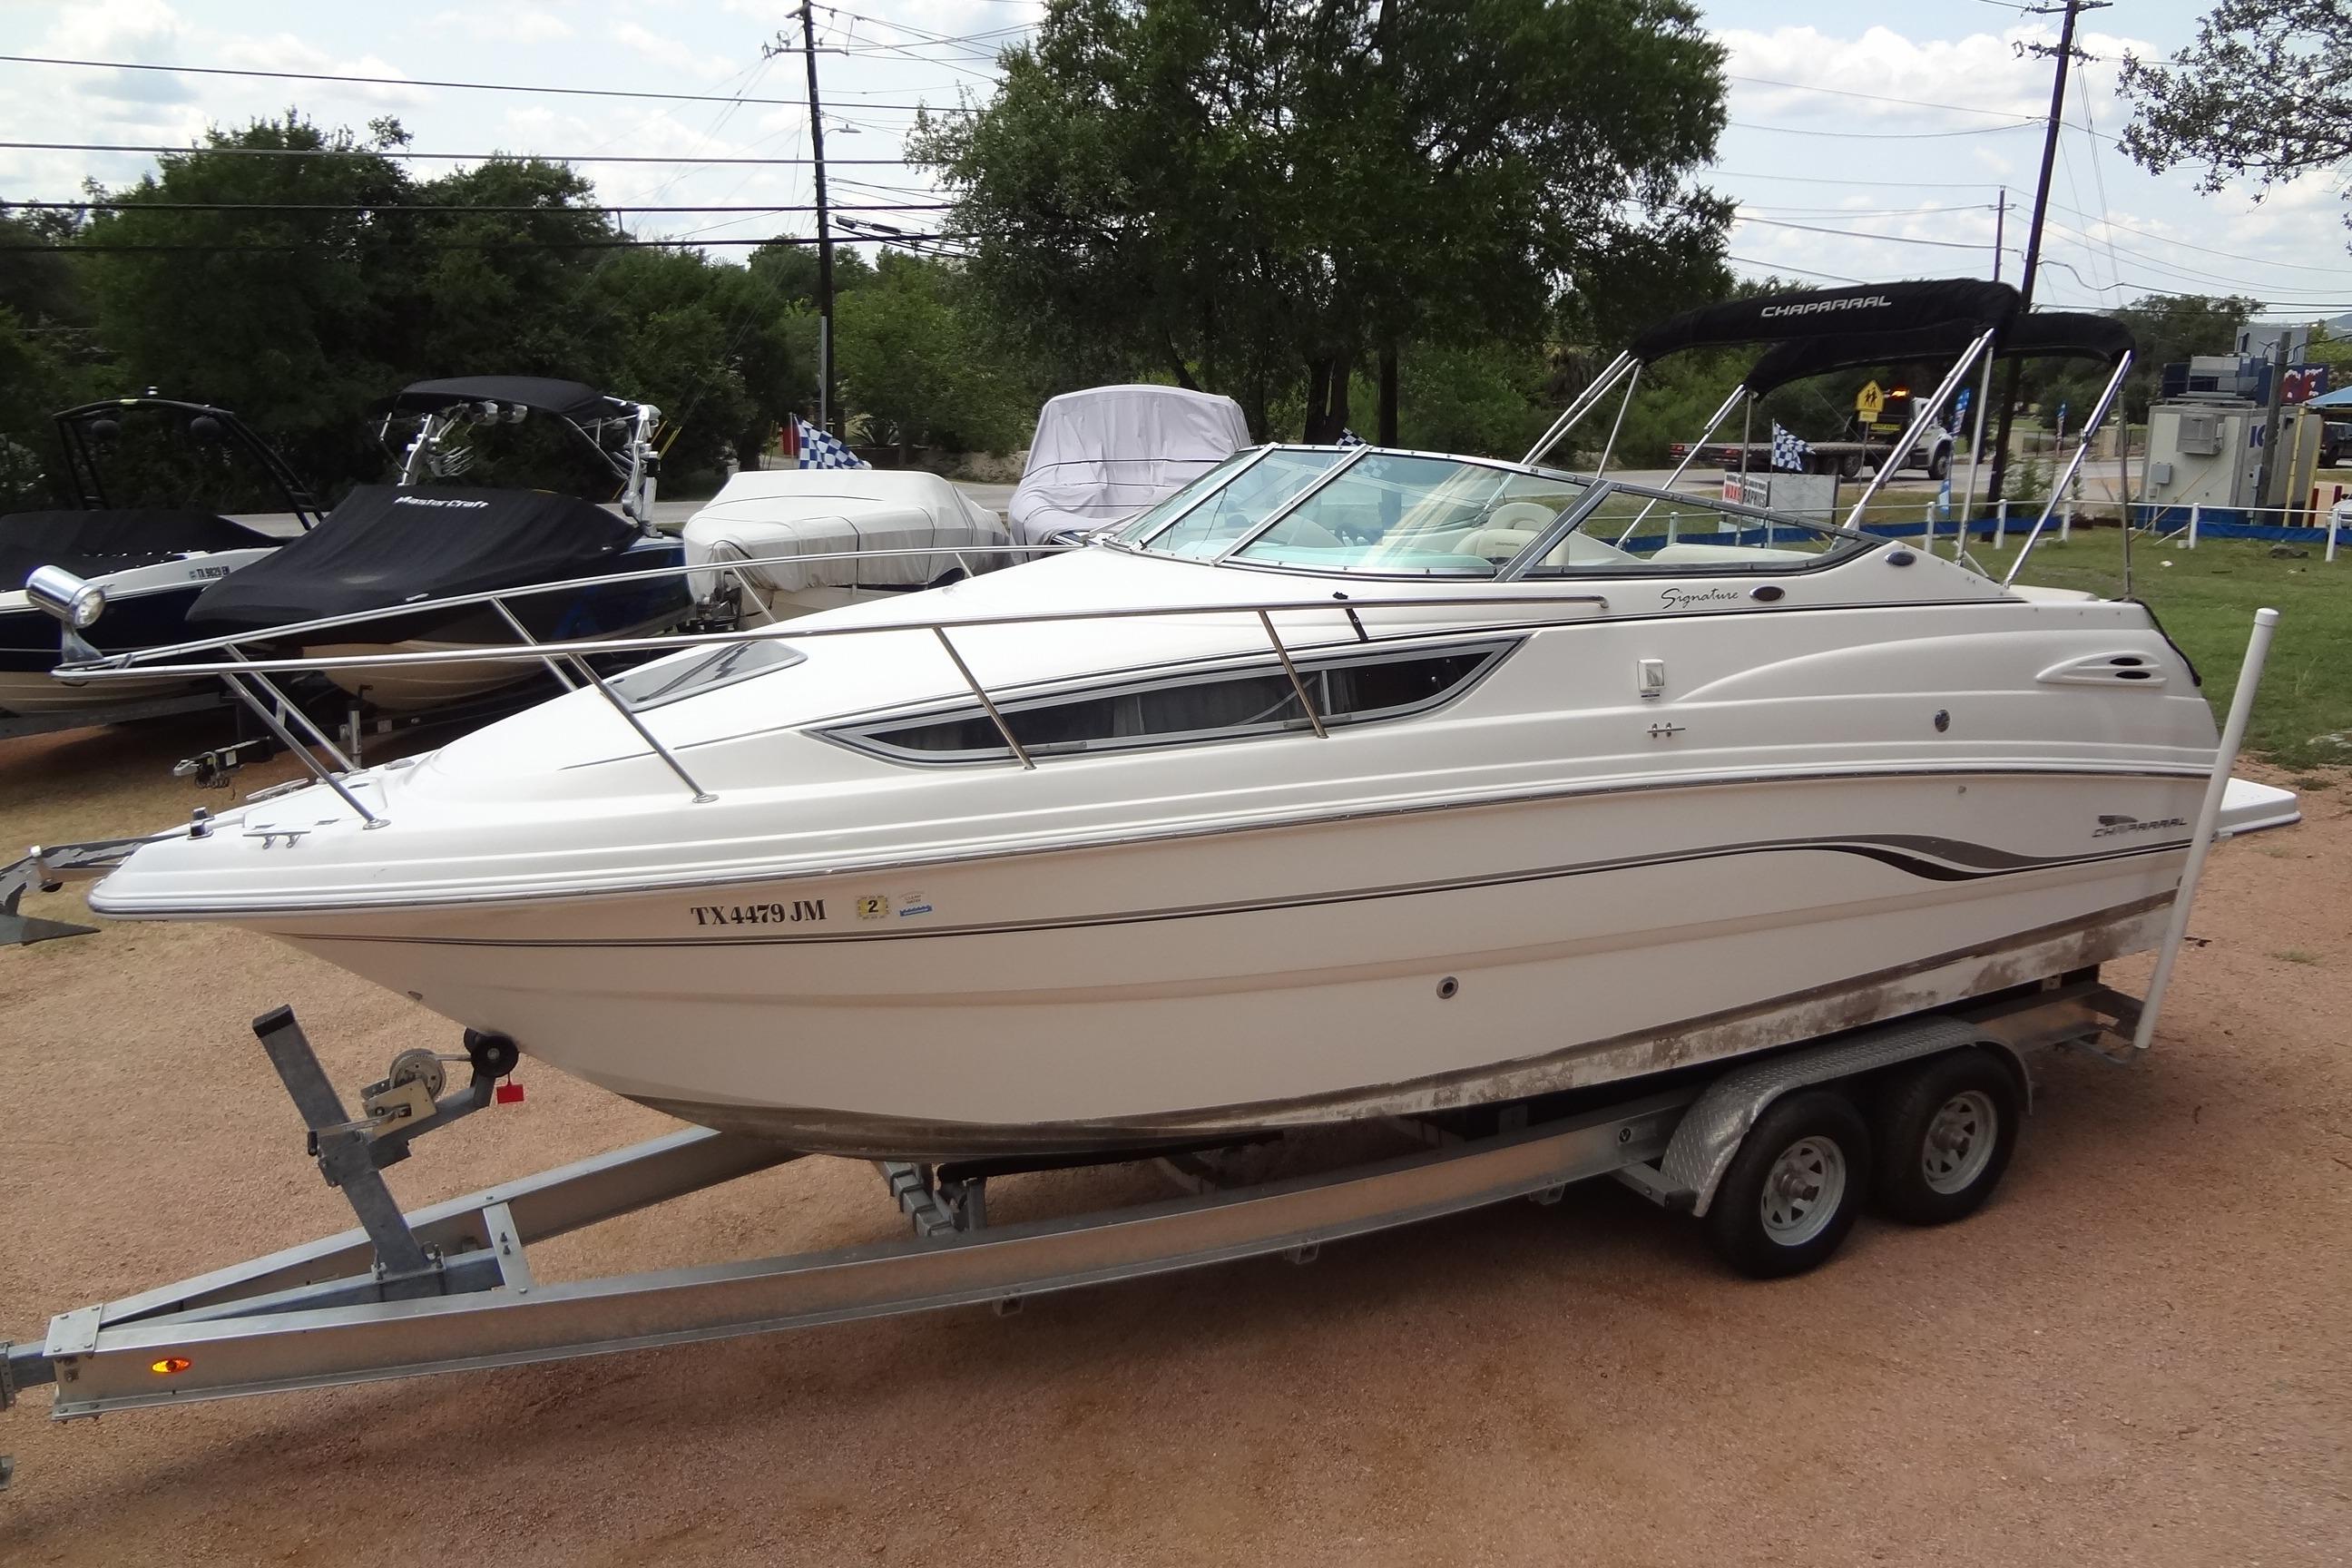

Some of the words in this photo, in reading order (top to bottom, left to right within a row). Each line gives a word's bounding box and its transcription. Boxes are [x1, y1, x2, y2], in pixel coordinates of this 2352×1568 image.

[1760, 295, 1892, 318] CHAPARRAL
[395, 495, 489, 508] MasterCraft
[1661, 588, 1739, 610] Signature
[691, 906, 730, 926] TX
[730, 903, 786, 925] 4479
[790, 898, 828, 922] JM
[867, 899, 879, 914] 2
